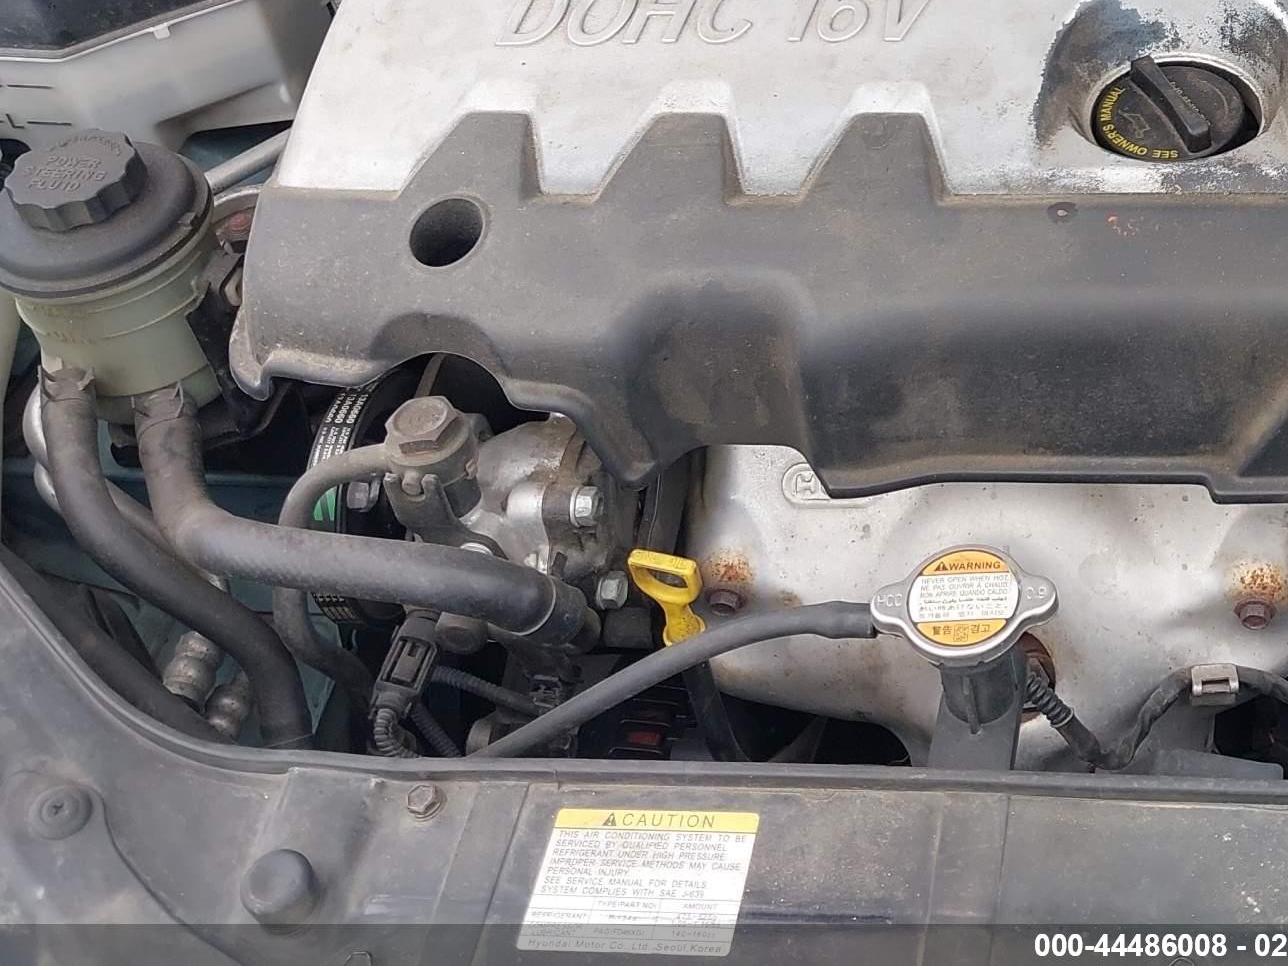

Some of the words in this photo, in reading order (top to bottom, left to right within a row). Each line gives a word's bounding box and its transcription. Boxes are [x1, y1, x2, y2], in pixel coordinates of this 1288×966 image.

[1101, 87, 1126, 123] MANUAL
[1103, 123, 1149, 156] OWNER'S
[1152, 149, 1179, 159] SEE
[46, 155, 102, 170] POWER
[25, 164, 108, 182] STEERING
[28, 178, 81, 192] FLUID
[948, 561, 1001, 570] WARNING
[622, 813, 715, 828] CAUTION
[604, 832, 670, 841] CONDITIONING
[676, 833, 712, 841] SYSTEM
[555, 839, 600, 847] SERVICED
[622, 841, 670, 849] QUALIFIED
[674, 843, 728, 852] PERSONNEL
[552, 849, 615, 857] REFRIGERANT
[616, 850, 648, 858] UNDER
[550, 858, 596, 867] IMPROPER
[600, 859, 638, 867] SERVICE
[641, 861, 685, 869] METHODS
[688, 862, 707, 870] MAY
[711, 863, 742, 871] CAUSE
[546, 867, 593, 875] PERSONAL
[544, 876, 561, 884] SEE
[566, 877, 604, 885] SERVICE
[608, 878, 643, 886] MANUAL
[648, 879, 668, 887] FOR
[541, 885, 578, 894] SYSTEM
[582, 887, 626, 896] COMPLIES
[528, 939, 571, 948] Hyundai
[576, 940, 606, 948] Motor
